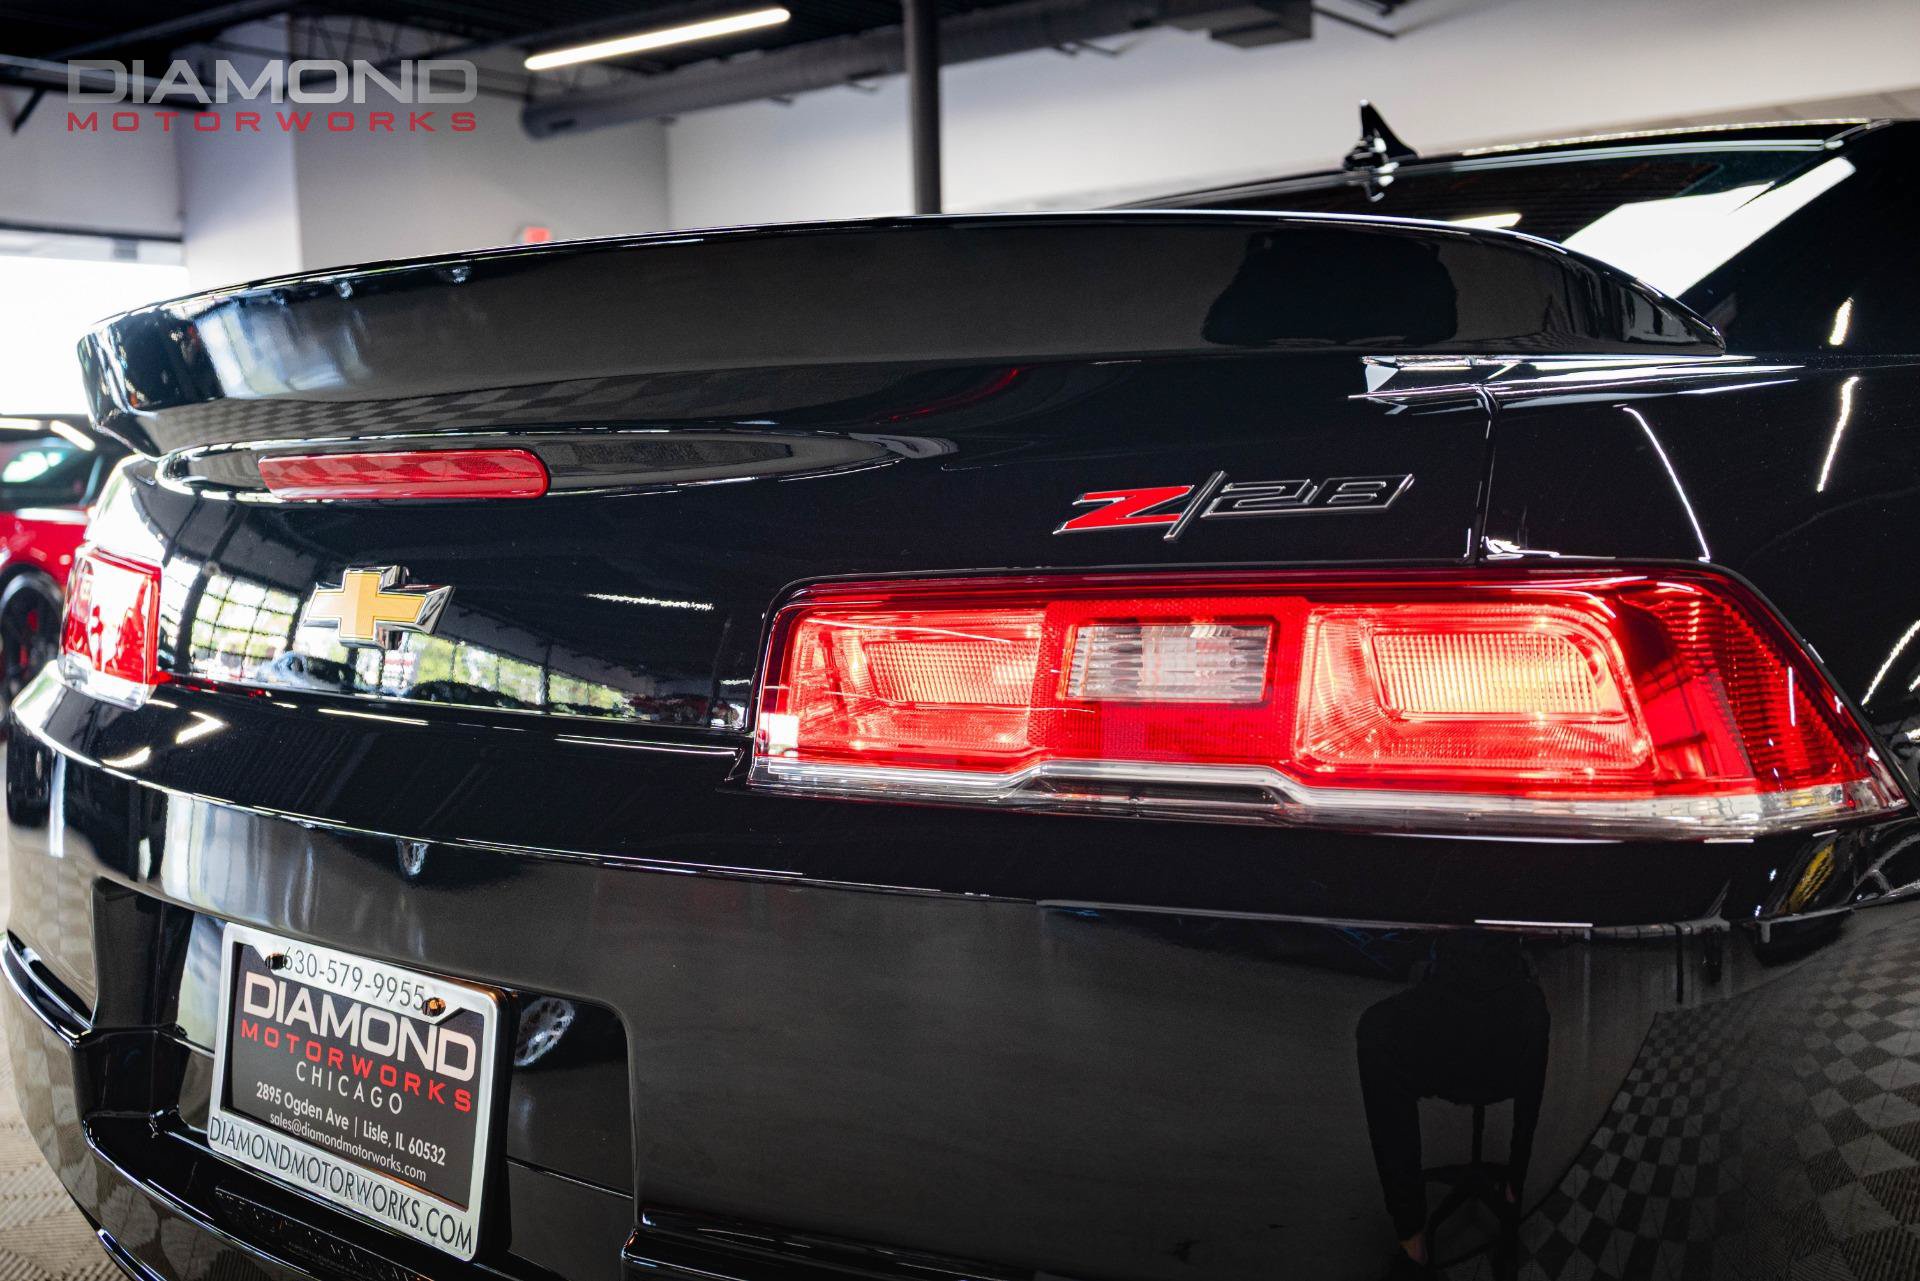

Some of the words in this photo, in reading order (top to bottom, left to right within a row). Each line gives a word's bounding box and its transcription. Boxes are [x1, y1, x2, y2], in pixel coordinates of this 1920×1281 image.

[282, 946, 425, 1011] 630-579-9955
[241, 1019, 472, 1113] MOTORWORKS
[243, 971, 477, 1082] DIAMOND
[256, 1081, 282, 1105] 2895
[284, 1091, 323, 1120] Ogden
[325, 1107, 349, 1130] Ave
[363, 1120, 392, 1148] Lisle,
[395, 1132, 405, 1151] IL
[408, 1137, 446, 1166] 60532
[296, 1061, 403, 1115] CHICAGO
[209, 1116, 473, 1254] DIAMONDMOTORWORKS.COM
[270, 1112, 427, 1183] sales@diamondmotorworks.com
